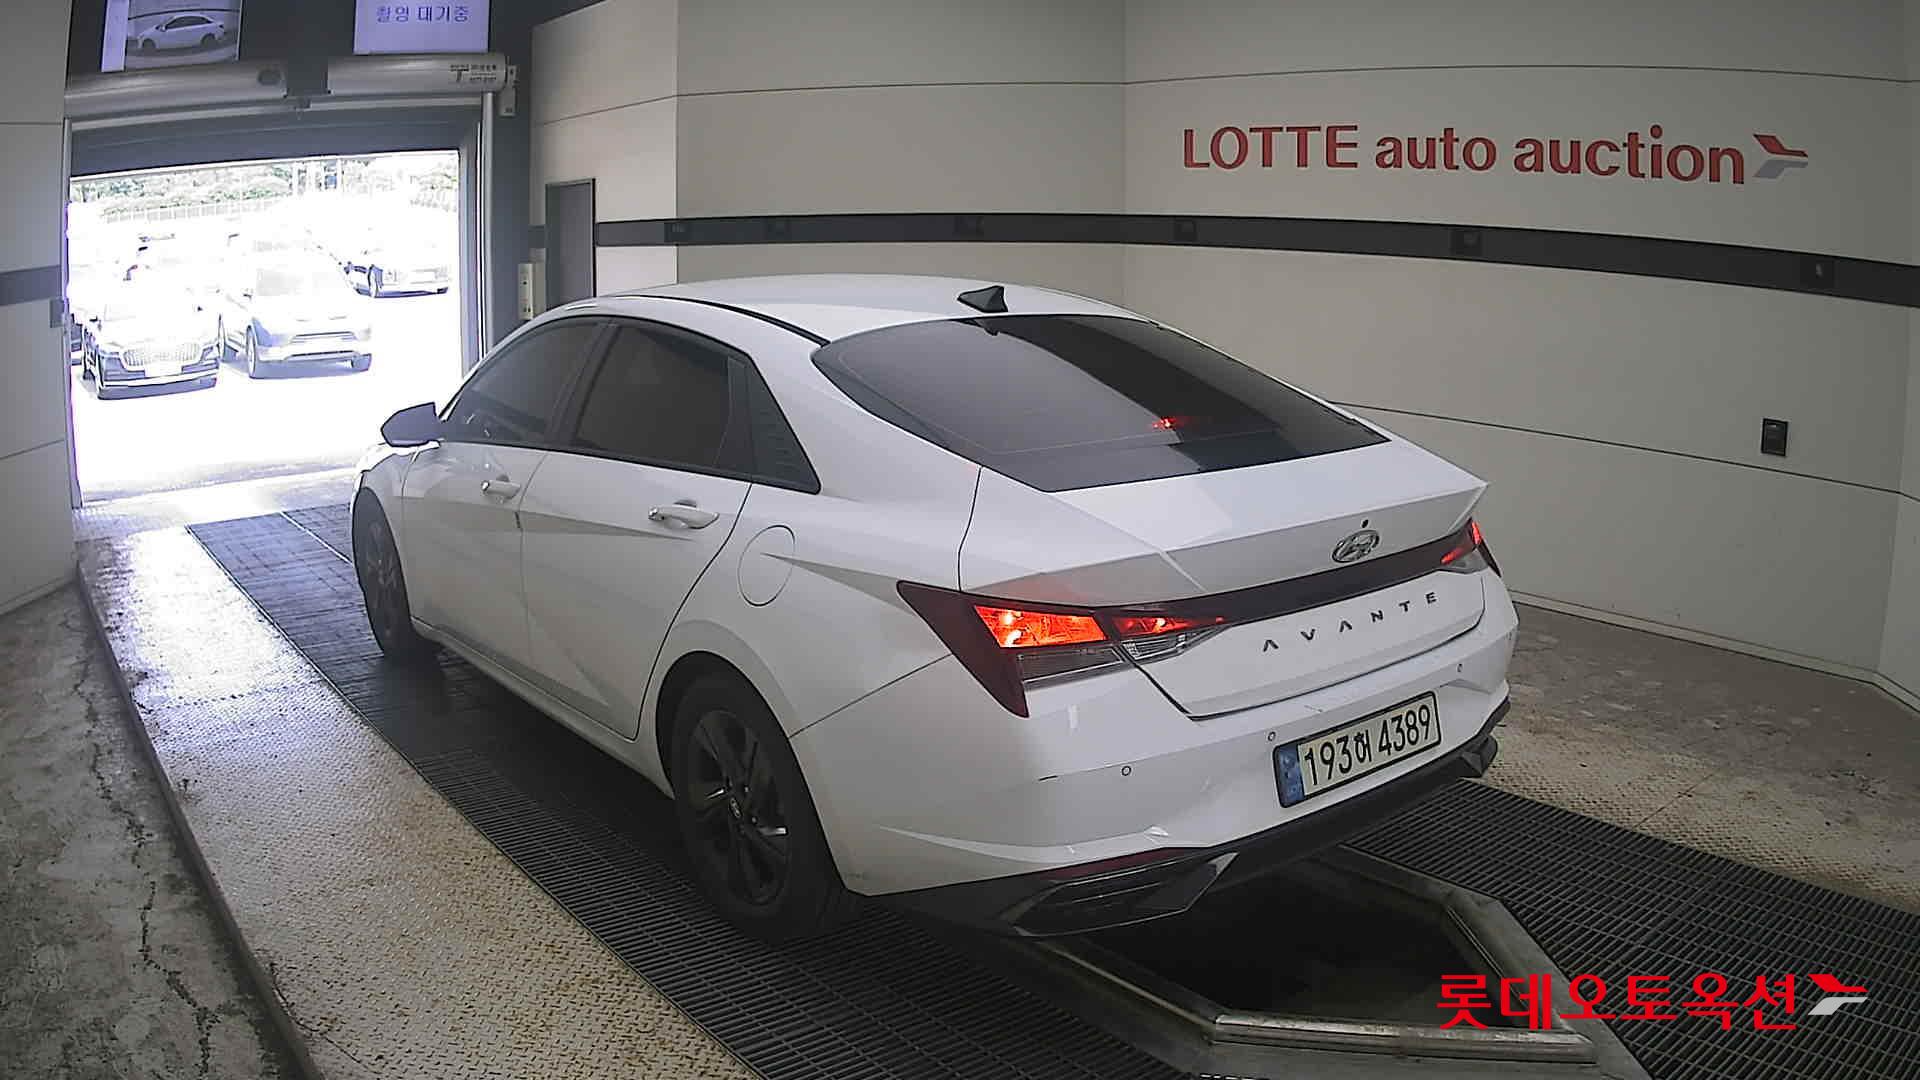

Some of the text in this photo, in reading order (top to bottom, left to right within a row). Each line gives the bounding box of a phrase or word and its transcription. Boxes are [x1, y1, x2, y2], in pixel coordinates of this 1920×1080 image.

[418, 6, 469, 22] 대기중
[1183, 125, 1745, 184] LOTTE auto auction
[1262, 591, 1440, 653] AVANTE
[1303, 704, 1432, 786] 193허 4389
